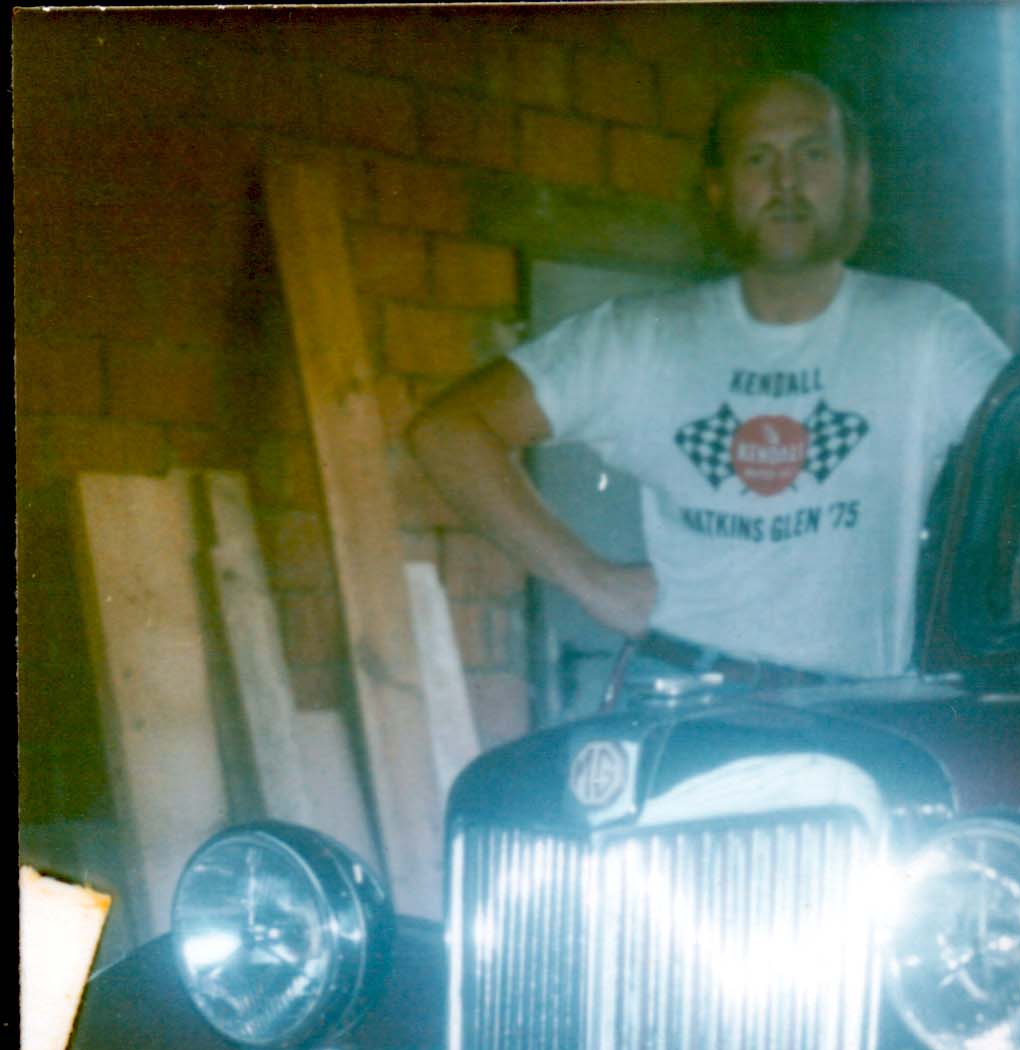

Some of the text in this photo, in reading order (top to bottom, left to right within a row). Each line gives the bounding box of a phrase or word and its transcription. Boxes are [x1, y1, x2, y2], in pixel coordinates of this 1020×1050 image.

[729, 367, 824, 398] KENDALL
[769, 506, 822, 543] GLEN
[828, 500, 861, 529] '75
